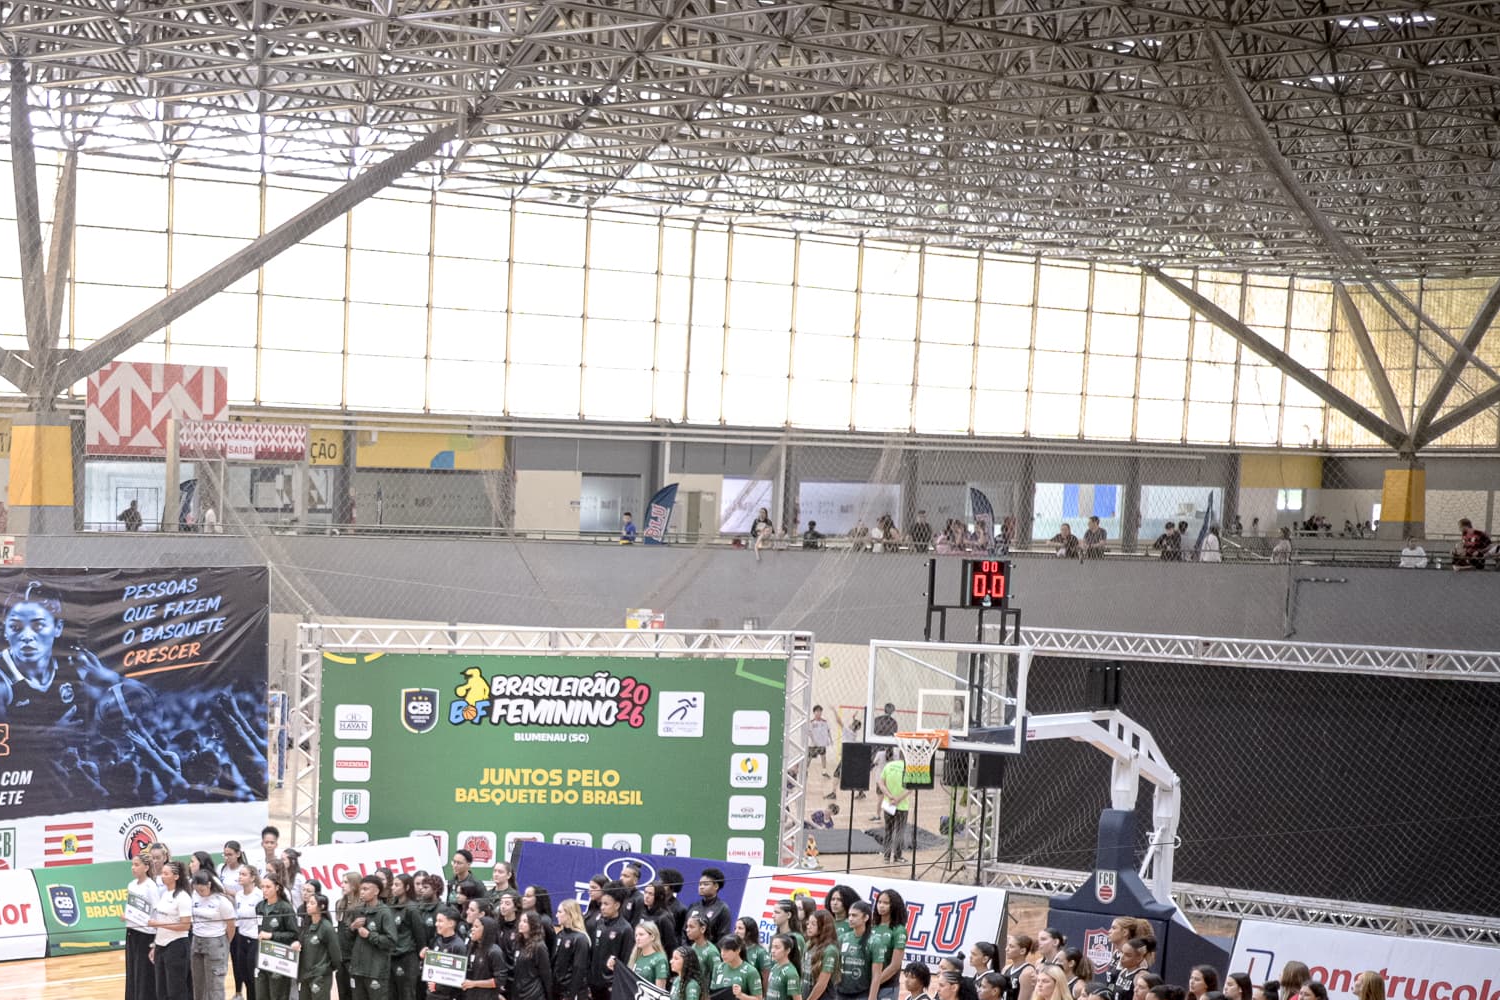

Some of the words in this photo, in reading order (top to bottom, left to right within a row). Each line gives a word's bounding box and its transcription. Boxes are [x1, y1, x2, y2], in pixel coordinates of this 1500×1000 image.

[228, 445, 254, 455] SAÍDA
[310, 438, 337, 464] ÇÃO
[123, 577, 199, 602] PESSOAS
[124, 604, 159, 622] QUE
[164, 596, 222, 618] FAZEM
[123, 629, 135, 645] O
[140, 617, 227, 643] BASQUETE
[124, 642, 202, 667] CRESCER
[491, 672, 621, 698] BRASILEIRÃO
[490, 698, 619, 727] FEMININO
[339, 722, 368, 731] HAVAN
[513, 732, 568, 743] BLUMENAU
[0, 769, 34, 786] COM
[480, 767, 563, 786] JUNTOS
[567, 769, 621, 788] PELO
[455, 788, 547, 806] BASQUETE
[551, 790, 579, 805] DO
[582, 790, 644, 806] BRASIL
[118, 812, 164, 835] BLUMENAU
